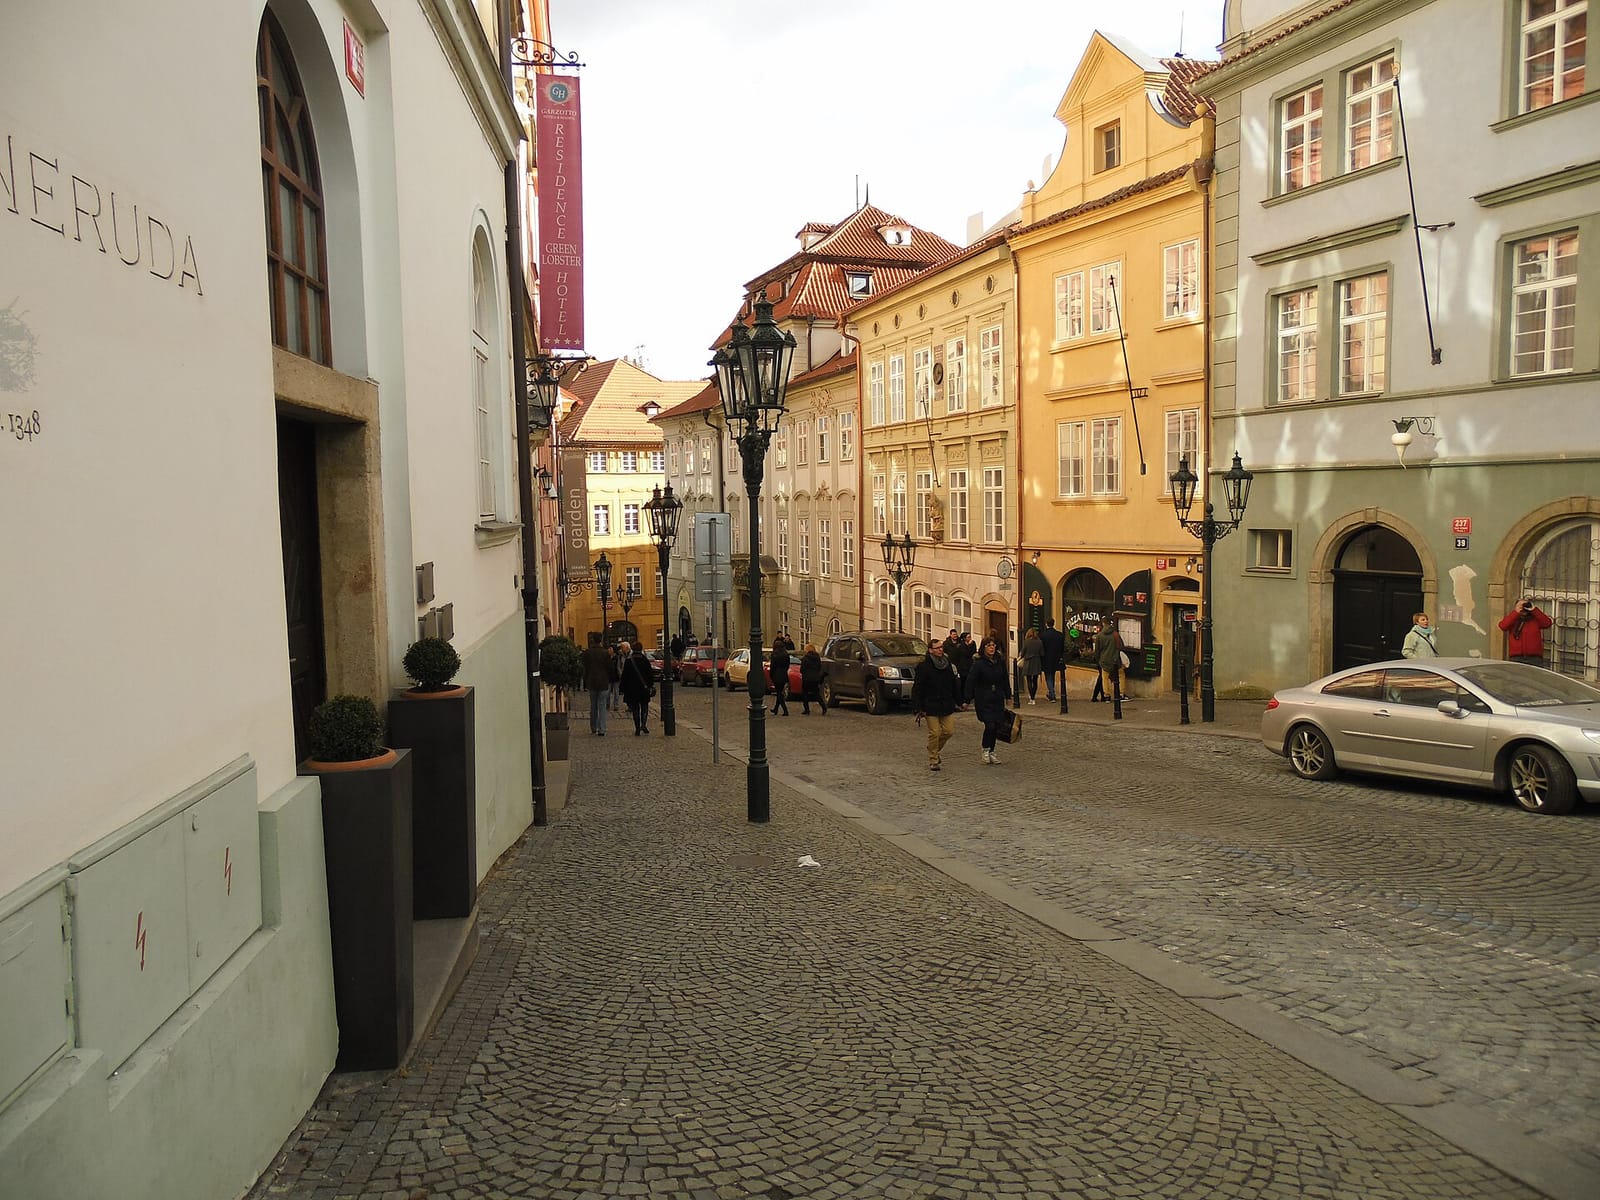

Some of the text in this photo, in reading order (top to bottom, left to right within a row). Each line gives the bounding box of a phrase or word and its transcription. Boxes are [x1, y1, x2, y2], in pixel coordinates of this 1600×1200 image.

[555, 123, 567, 239] RESIDENCE
[542, 254, 581, 267] LOBSTER
[545, 243, 577, 254] GREEN
[556, 271, 568, 335] HOTEL
[566, 488, 587, 549] garden
[1082, 611, 1100, 622] PASTA
